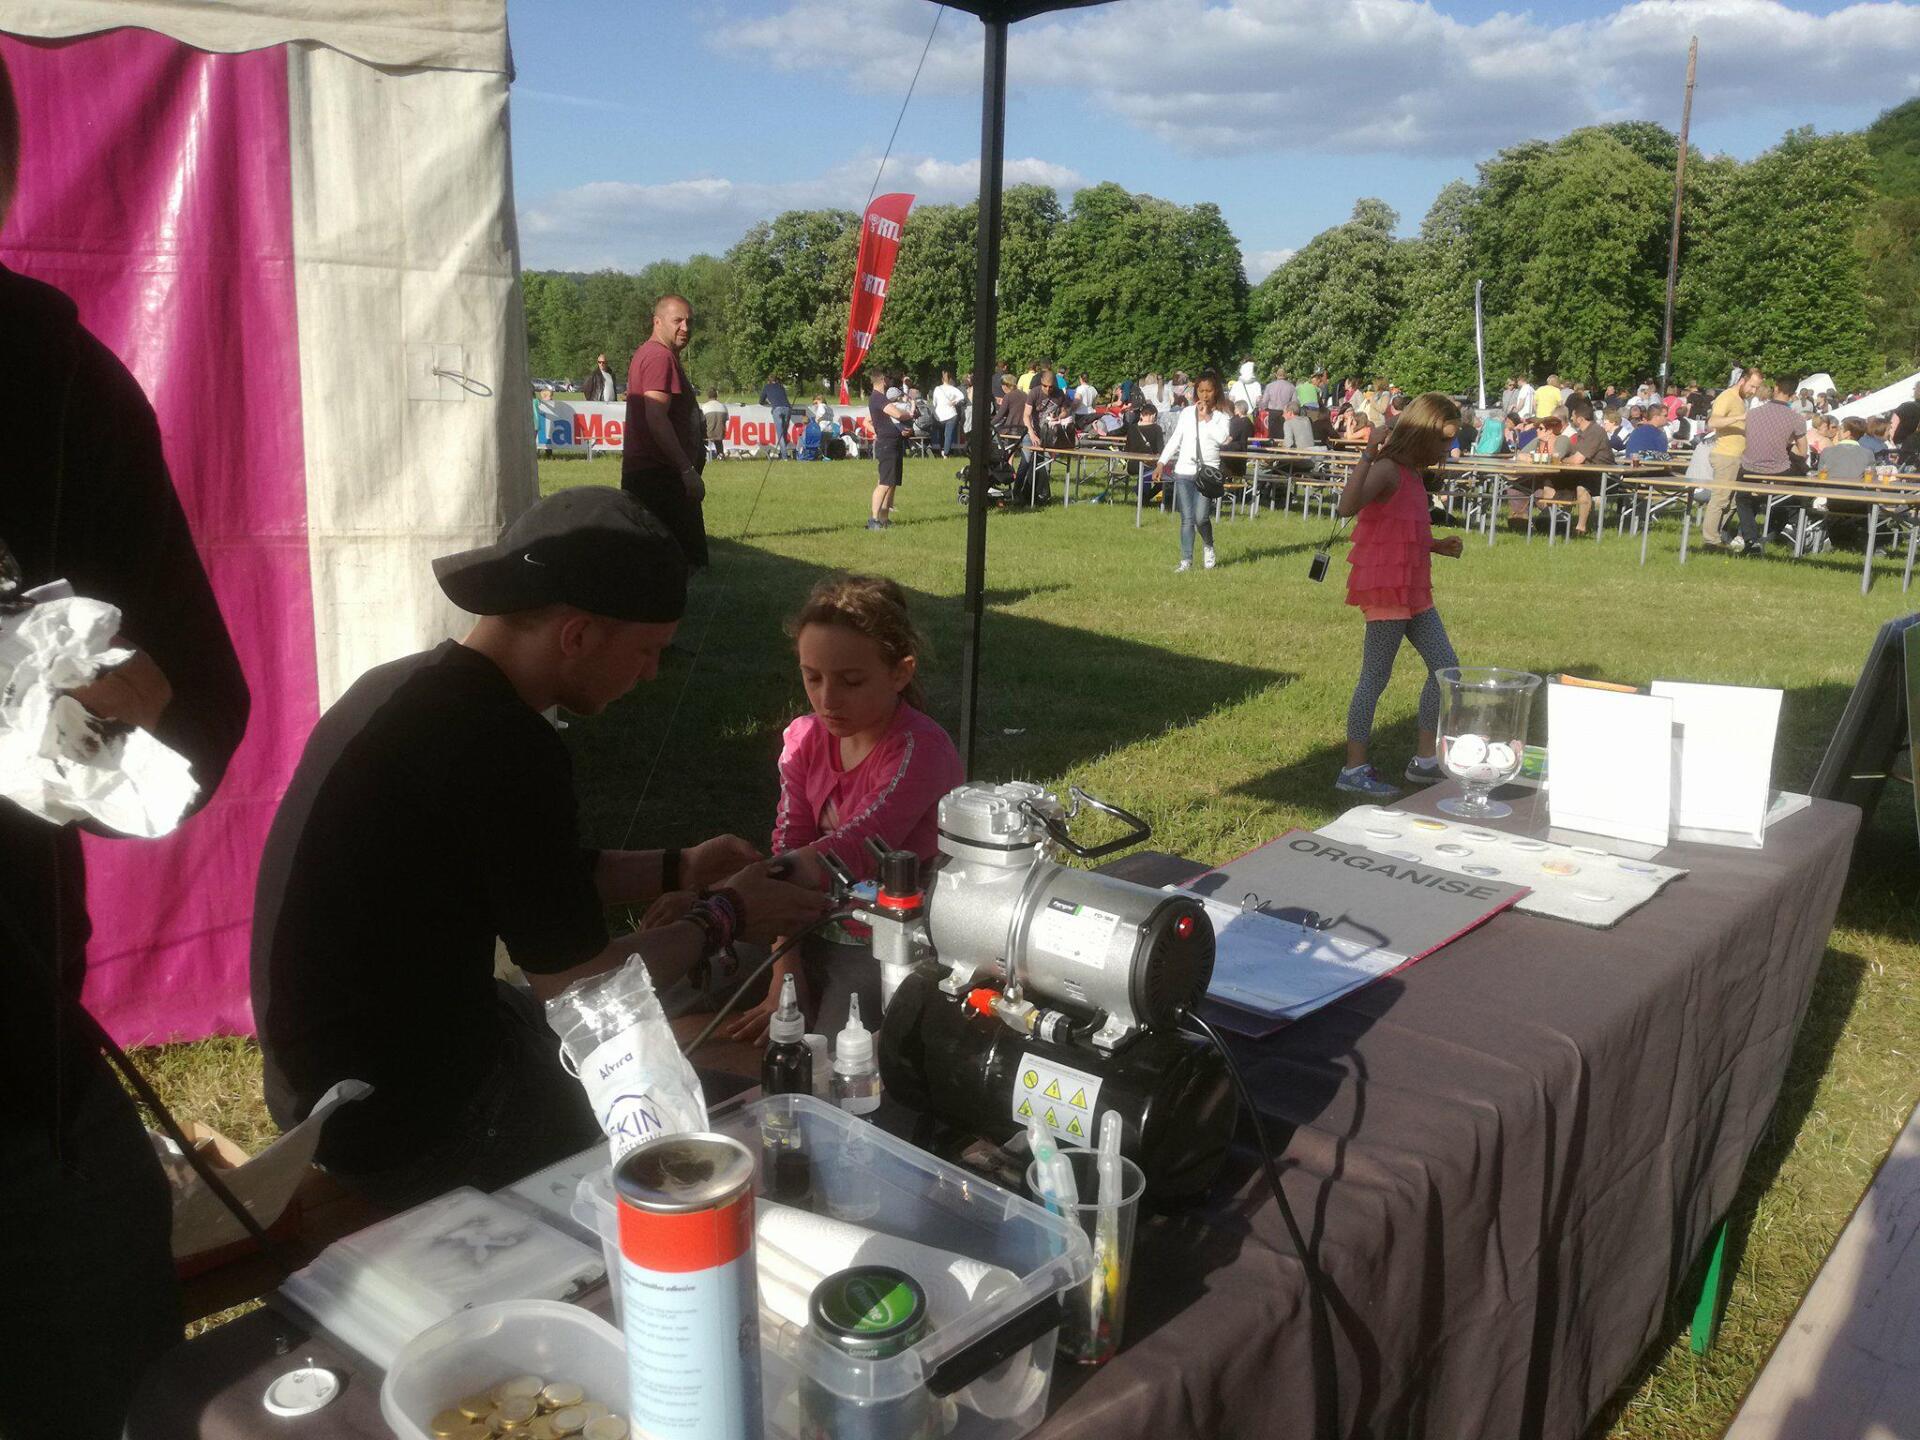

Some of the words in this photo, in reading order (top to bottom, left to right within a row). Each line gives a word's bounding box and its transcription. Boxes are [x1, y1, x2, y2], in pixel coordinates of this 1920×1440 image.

[877, 217, 900, 242] RTL
[864, 274, 886, 298] RTL
[1289, 838, 1502, 901] ORGANISE
